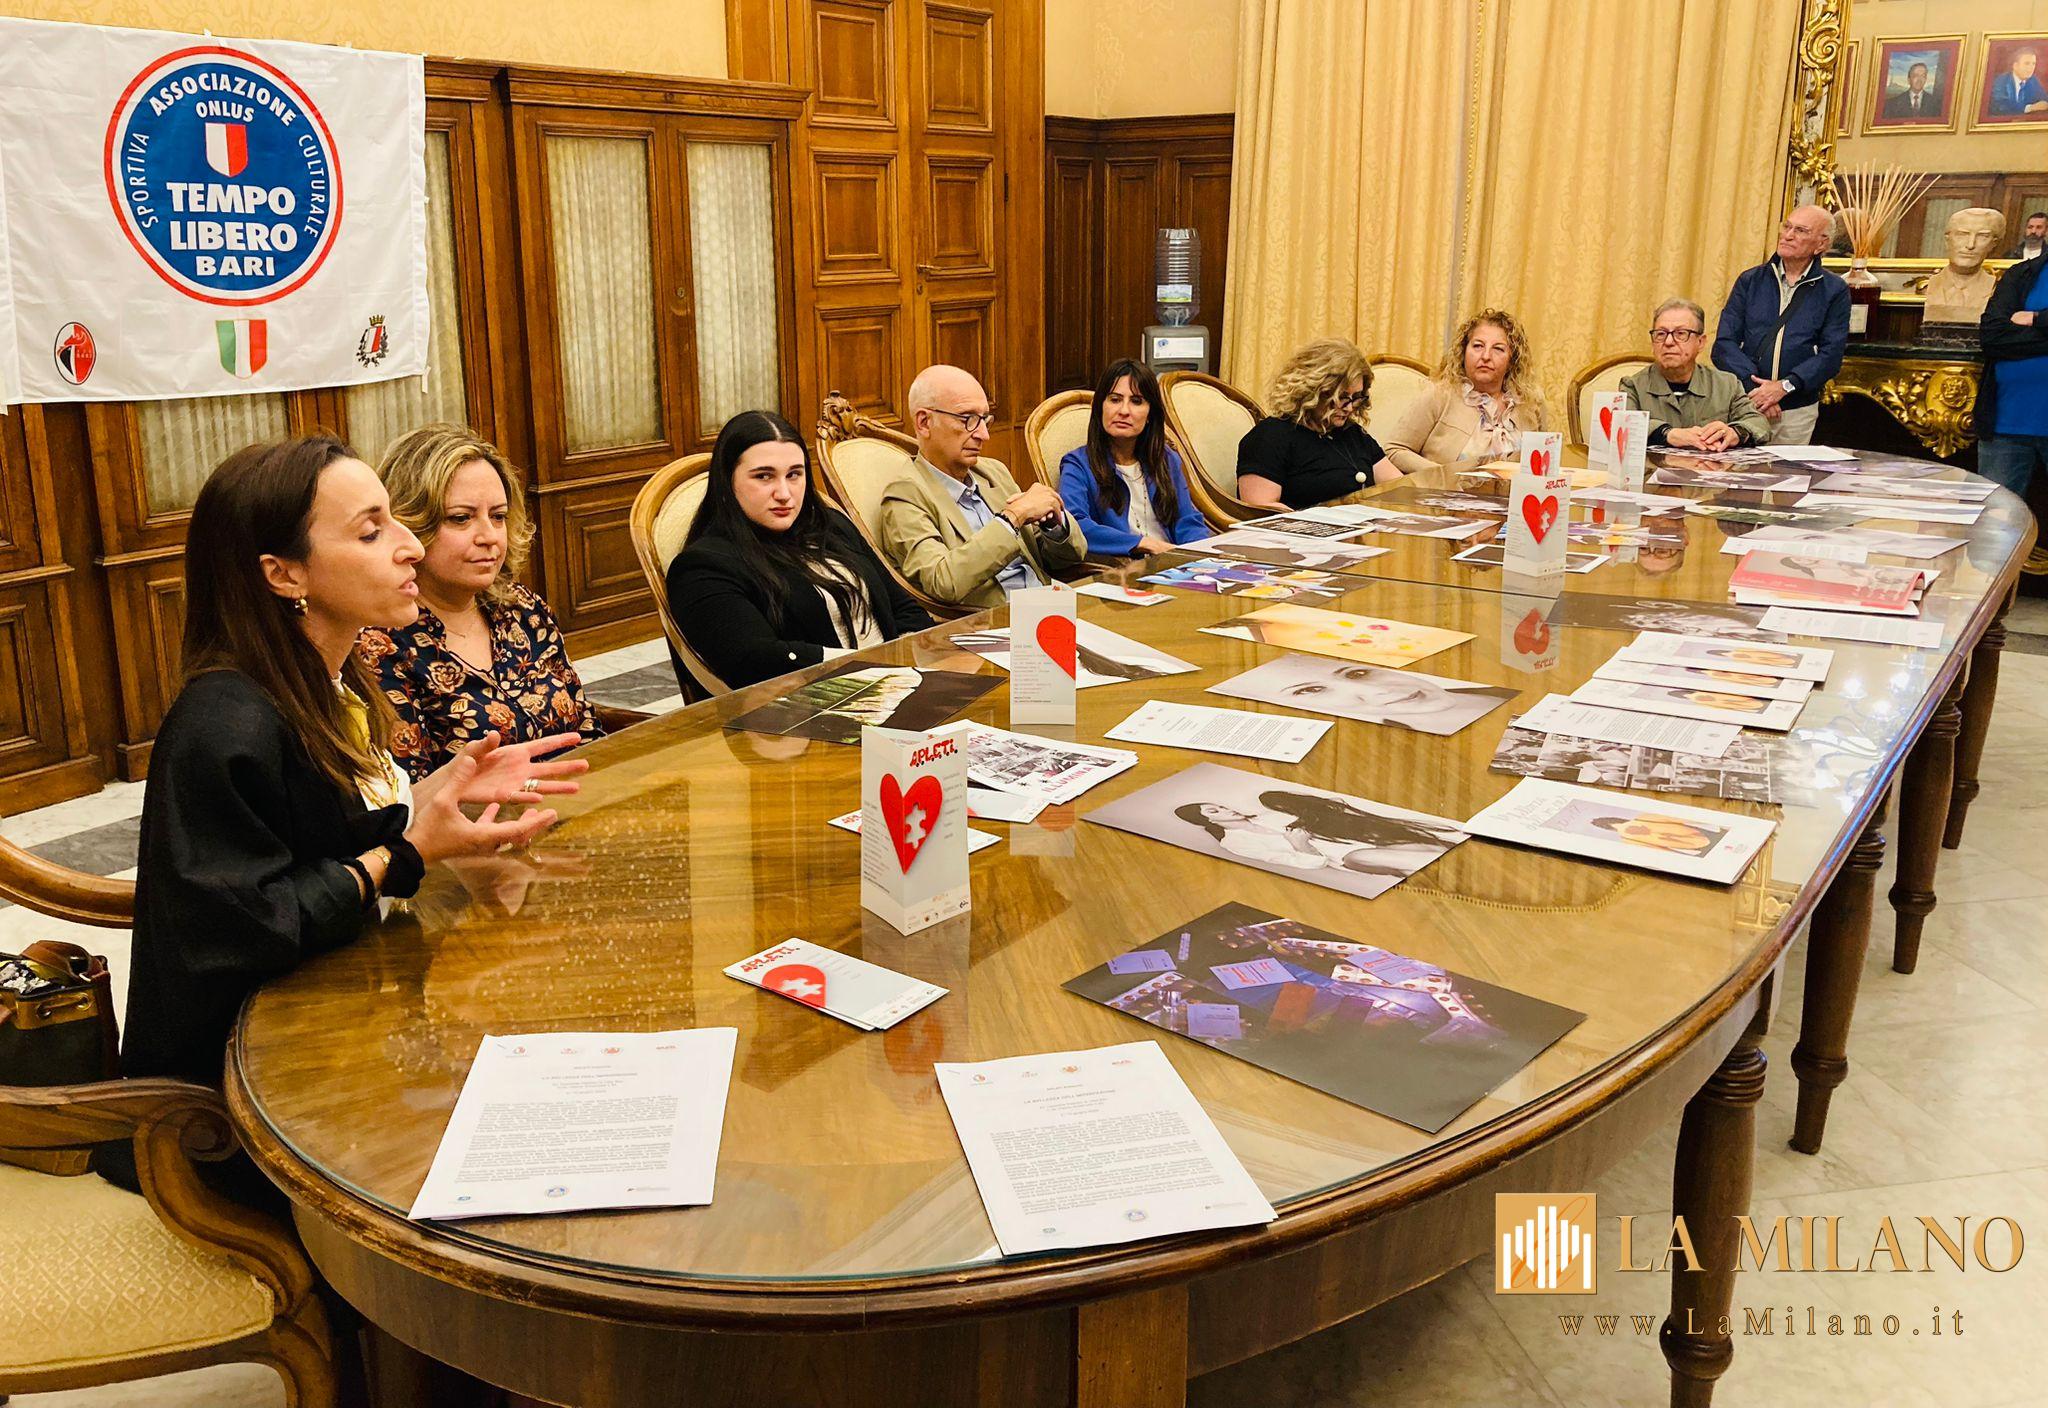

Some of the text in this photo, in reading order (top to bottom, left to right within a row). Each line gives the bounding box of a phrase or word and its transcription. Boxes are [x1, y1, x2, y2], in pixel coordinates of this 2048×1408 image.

[149, 72, 297, 126] ASSOCIAZIONE
[196, 100, 255, 122] ONLUS
[127, 132, 159, 229] SPORTIVA
[298, 133, 326, 238] CULTURALE
[166, 182, 296, 215] TEMPO
[169, 220, 298, 252] LIBERO
[196, 256, 276, 276] BARI
